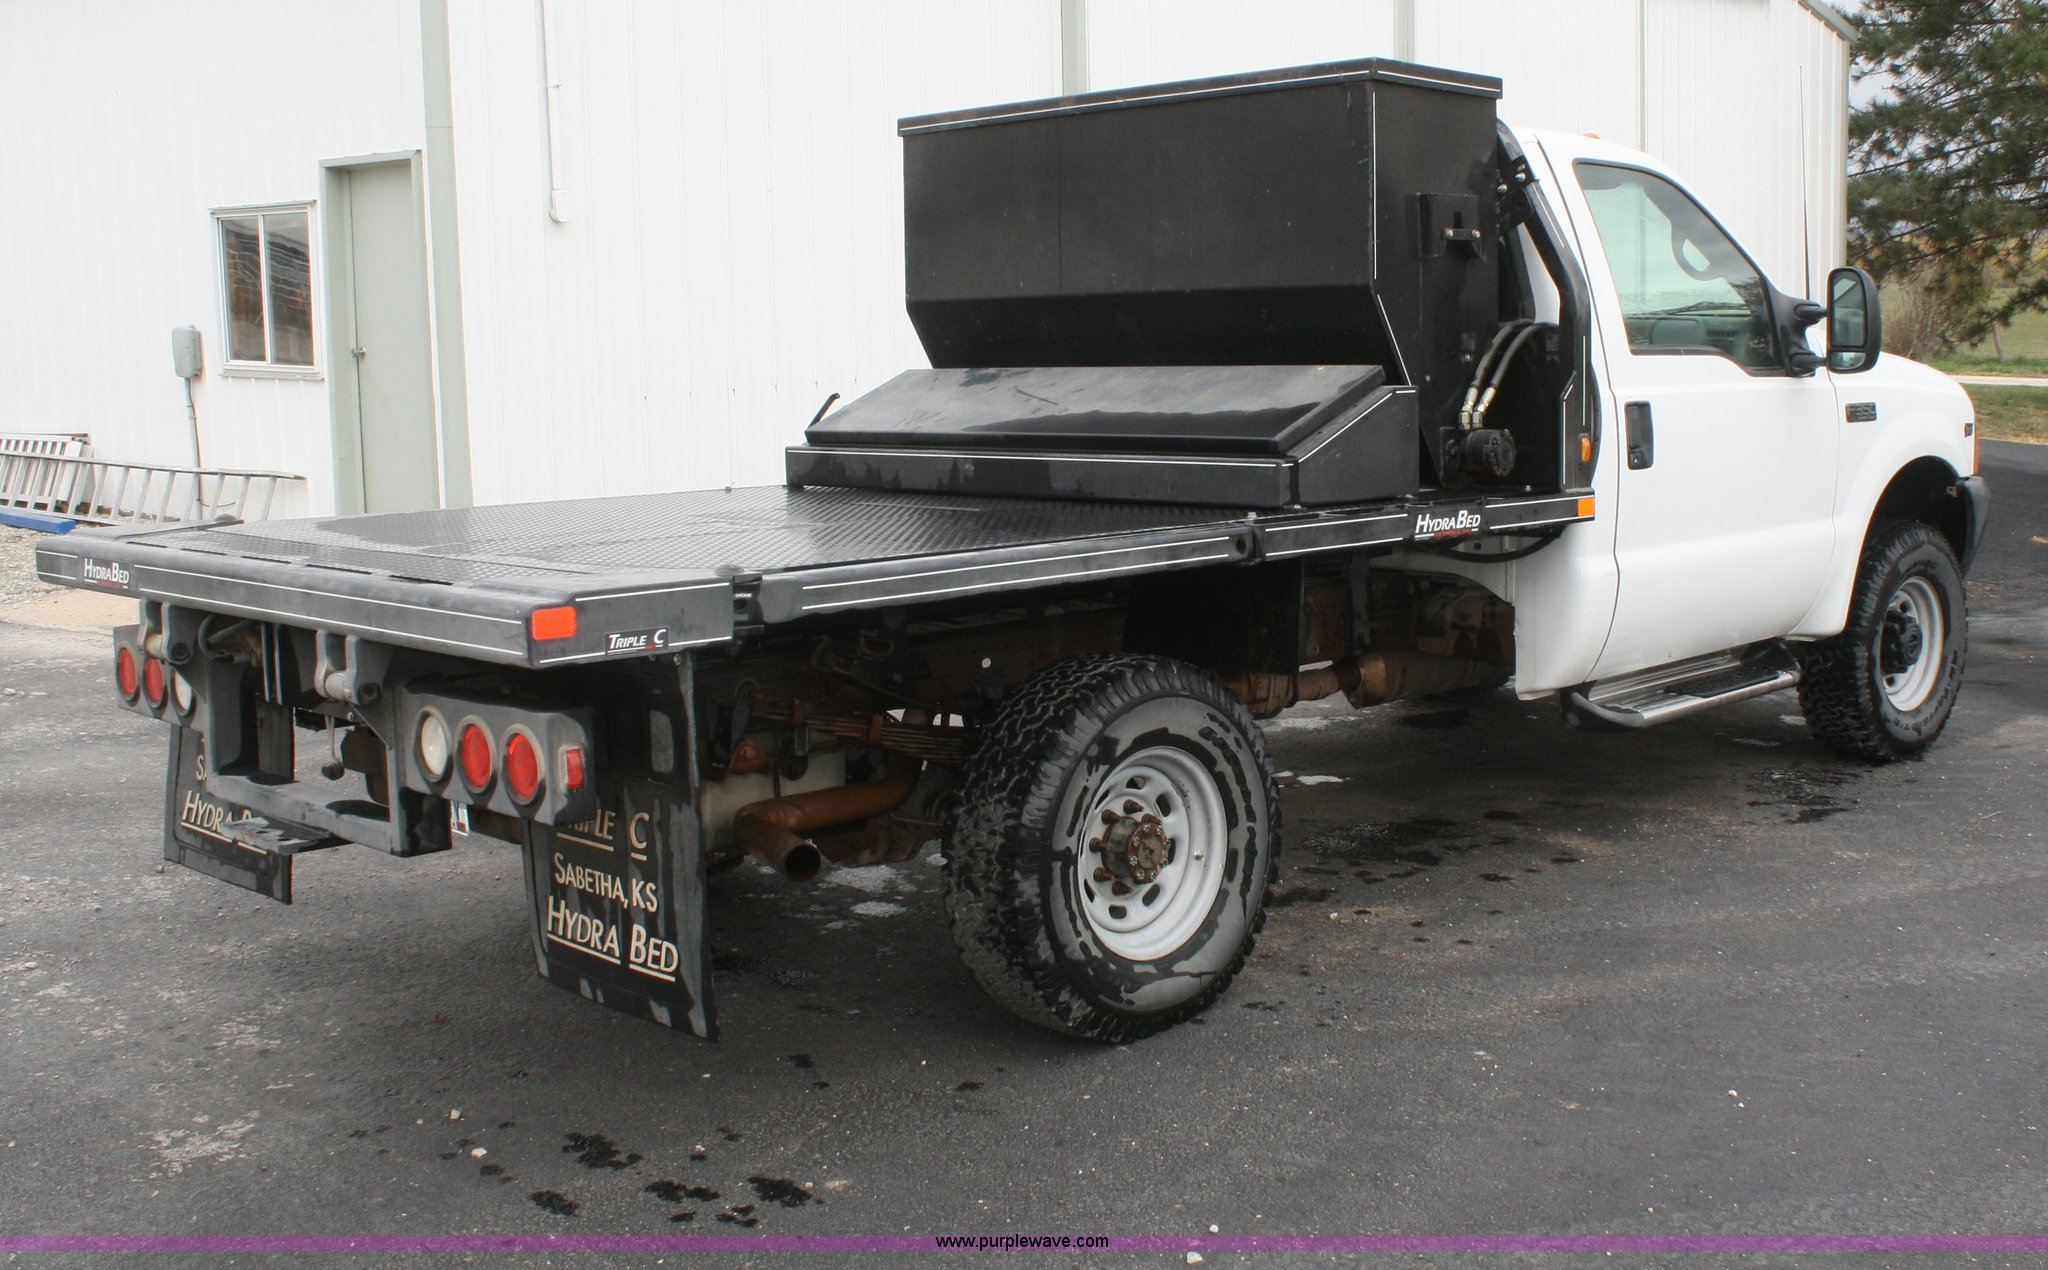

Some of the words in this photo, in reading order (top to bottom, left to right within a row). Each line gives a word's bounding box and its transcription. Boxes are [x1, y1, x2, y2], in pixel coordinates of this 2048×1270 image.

[1415, 510, 1481, 534] HYDRABED
[84, 558, 130, 584] HYDRABED
[609, 633, 648, 650] TRIPLE
[653, 628, 667, 644] C
[629, 812, 650, 850] C
[554, 852, 629, 909] SABETHA,
[632, 878, 658, 913] KS
[547, 895, 621, 958] HYDRA
[629, 923, 679, 973] BED
